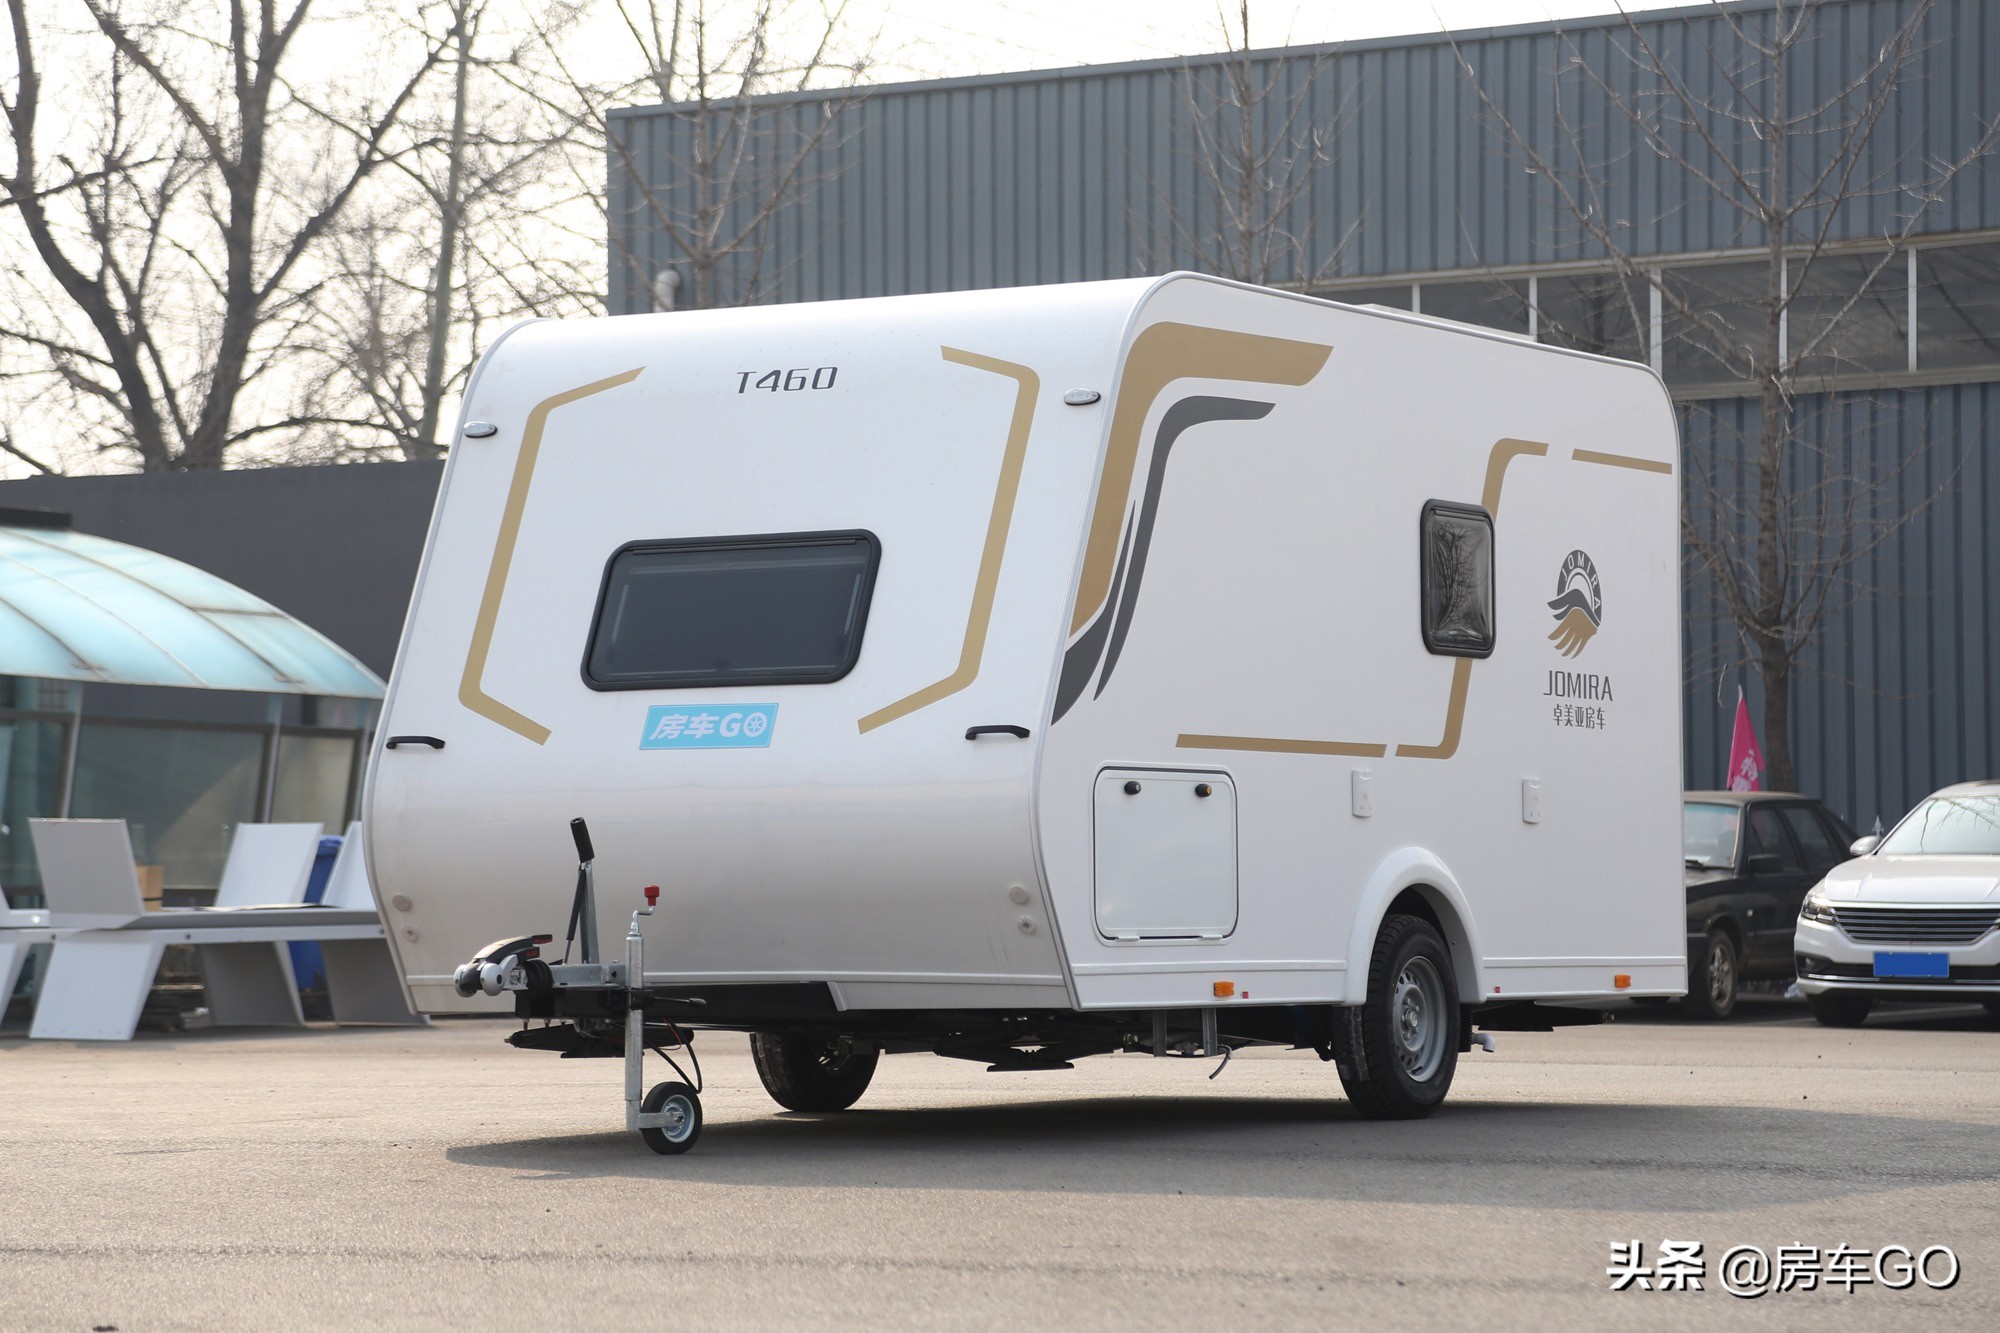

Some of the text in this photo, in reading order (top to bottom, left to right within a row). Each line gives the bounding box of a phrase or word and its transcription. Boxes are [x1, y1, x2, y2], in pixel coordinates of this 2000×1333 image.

[737, 367, 838, 394] T460
[1561, 551, 1601, 609] JOMIRA
[1543, 670, 1613, 701] JOMIRA
[1553, 703, 1606, 730] 卓美亚房车
